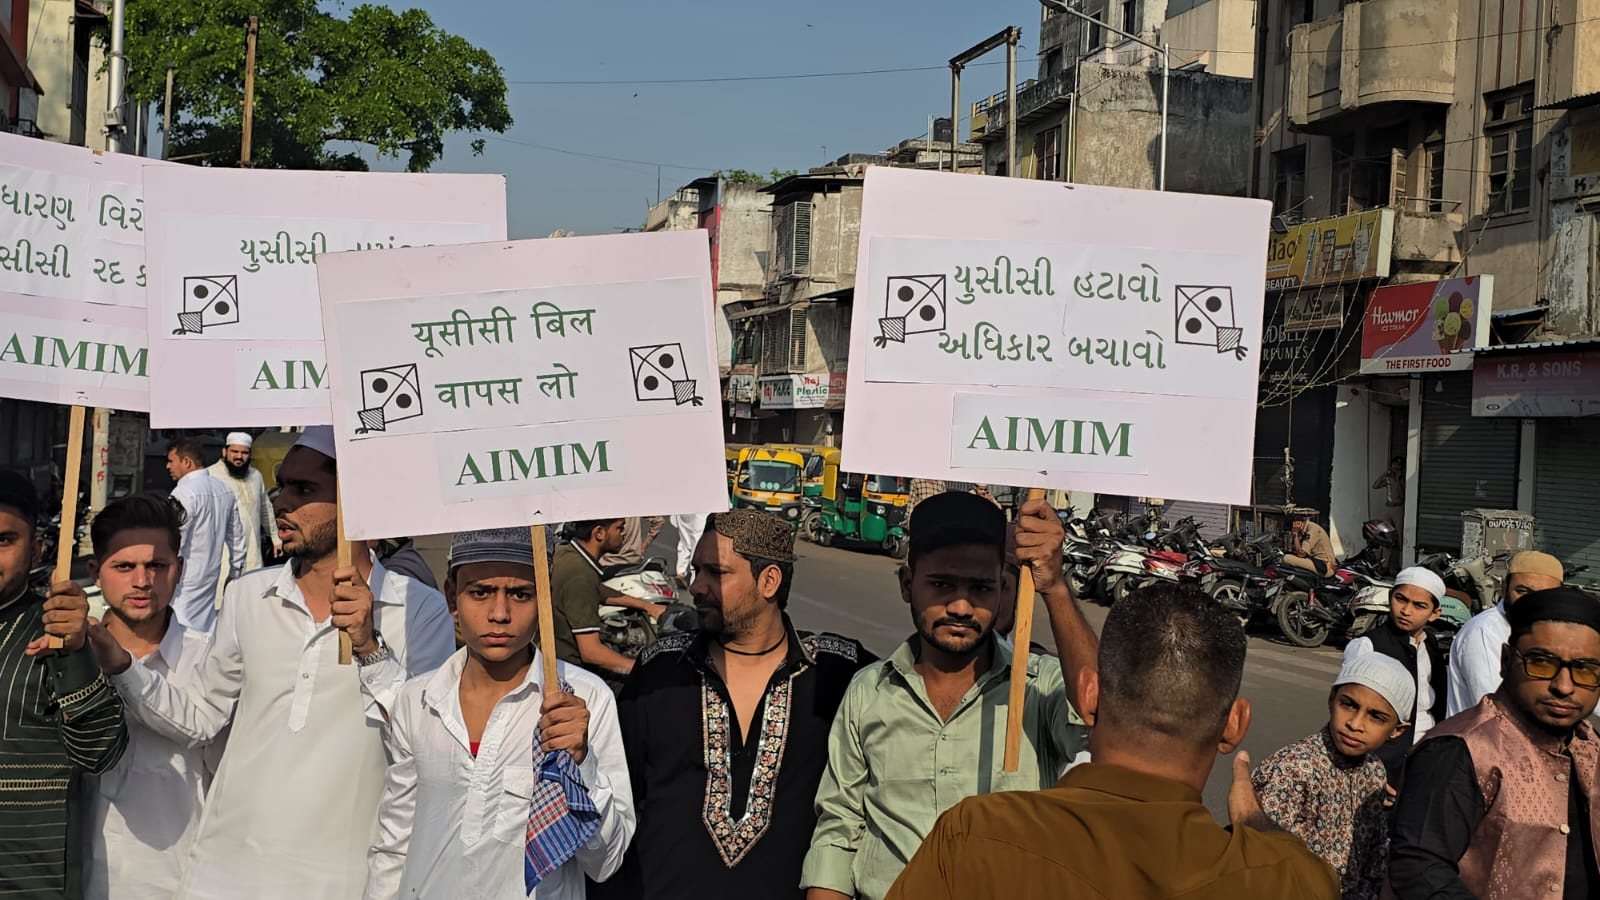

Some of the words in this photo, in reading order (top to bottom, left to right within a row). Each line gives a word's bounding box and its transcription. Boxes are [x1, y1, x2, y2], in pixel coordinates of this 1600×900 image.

[93, 258, 125, 284] રદ
[954, 255, 1055, 305] યુસીસી
[1073, 263, 1162, 303] હટાવો
[1265, 276, 1296, 290] BEAUTY
[411, 305, 517, 358] यूसीसी
[530, 301, 597, 341] बिल
[1371, 306, 1420, 325] Havmor
[0, 332, 149, 377] AIMIM
[938, 321, 1053, 362] અધિકાર
[1068, 330, 1166, 370] બચાવો
[1386, 360, 1401, 370] THE
[1402, 358, 1426, 369] FIRST
[1426, 358, 1451, 368] FOOD
[435, 377, 522, 409] वापस
[536, 363, 578, 400] लो
[1497, 363, 1523, 379] K.R.
[1527, 362, 1537, 377] &
[1542, 360, 1582, 377] SONS
[797, 386, 828, 396] Plastic
[967, 415, 1135, 457] AIMIM
[454, 440, 613, 486] AIMIM
